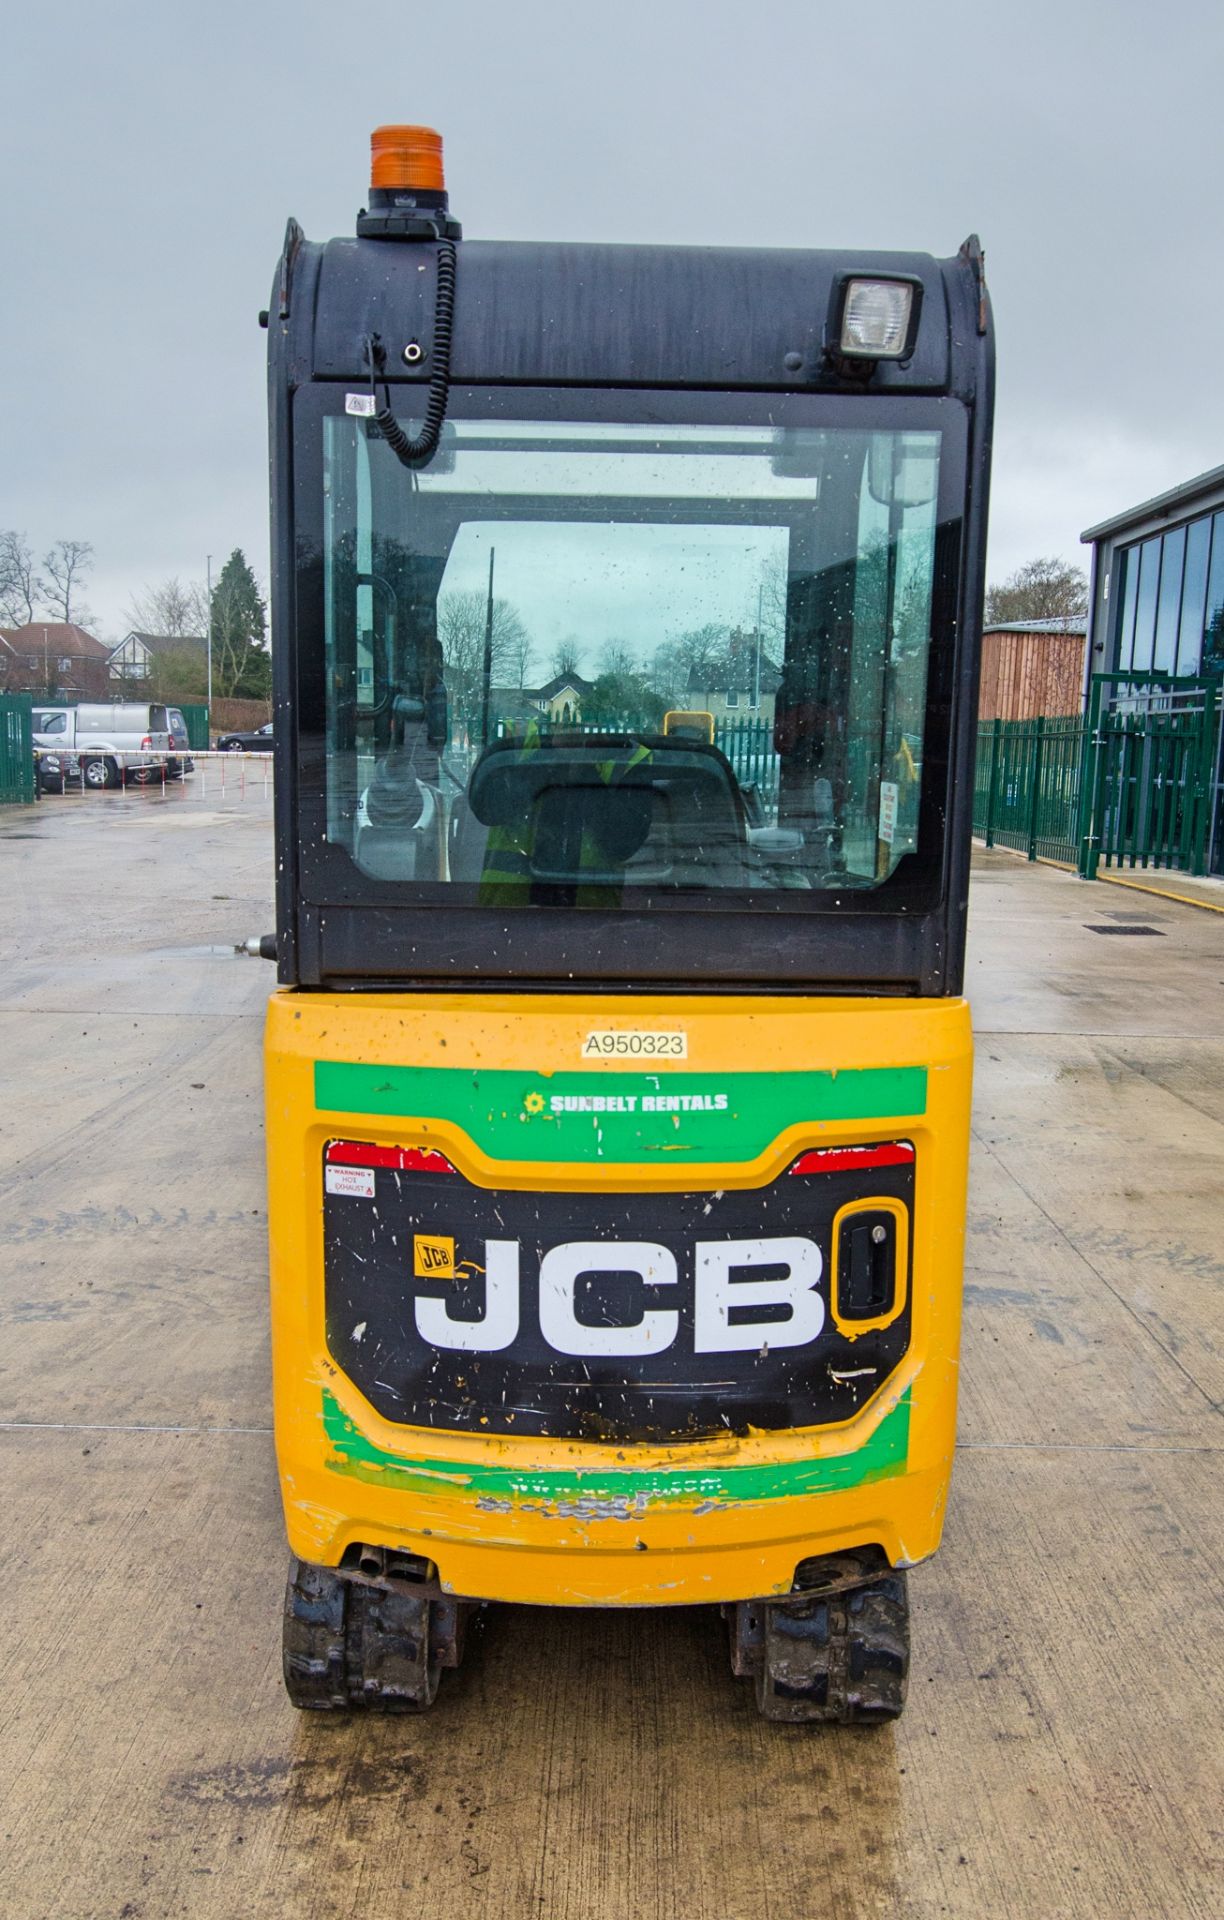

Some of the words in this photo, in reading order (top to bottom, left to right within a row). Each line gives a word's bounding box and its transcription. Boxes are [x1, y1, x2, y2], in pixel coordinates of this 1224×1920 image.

[586, 1035, 683, 1054] A950323
[550, 1096, 637, 1112] SUNBELT
[642, 1095, 728, 1111] RENTALS
[333, 1169, 366, 1177] WARNING
[335, 1183, 364, 1192] EXHAUST
[423, 1246, 449, 1268] JCB
[414, 1236, 825, 1356] JCB
